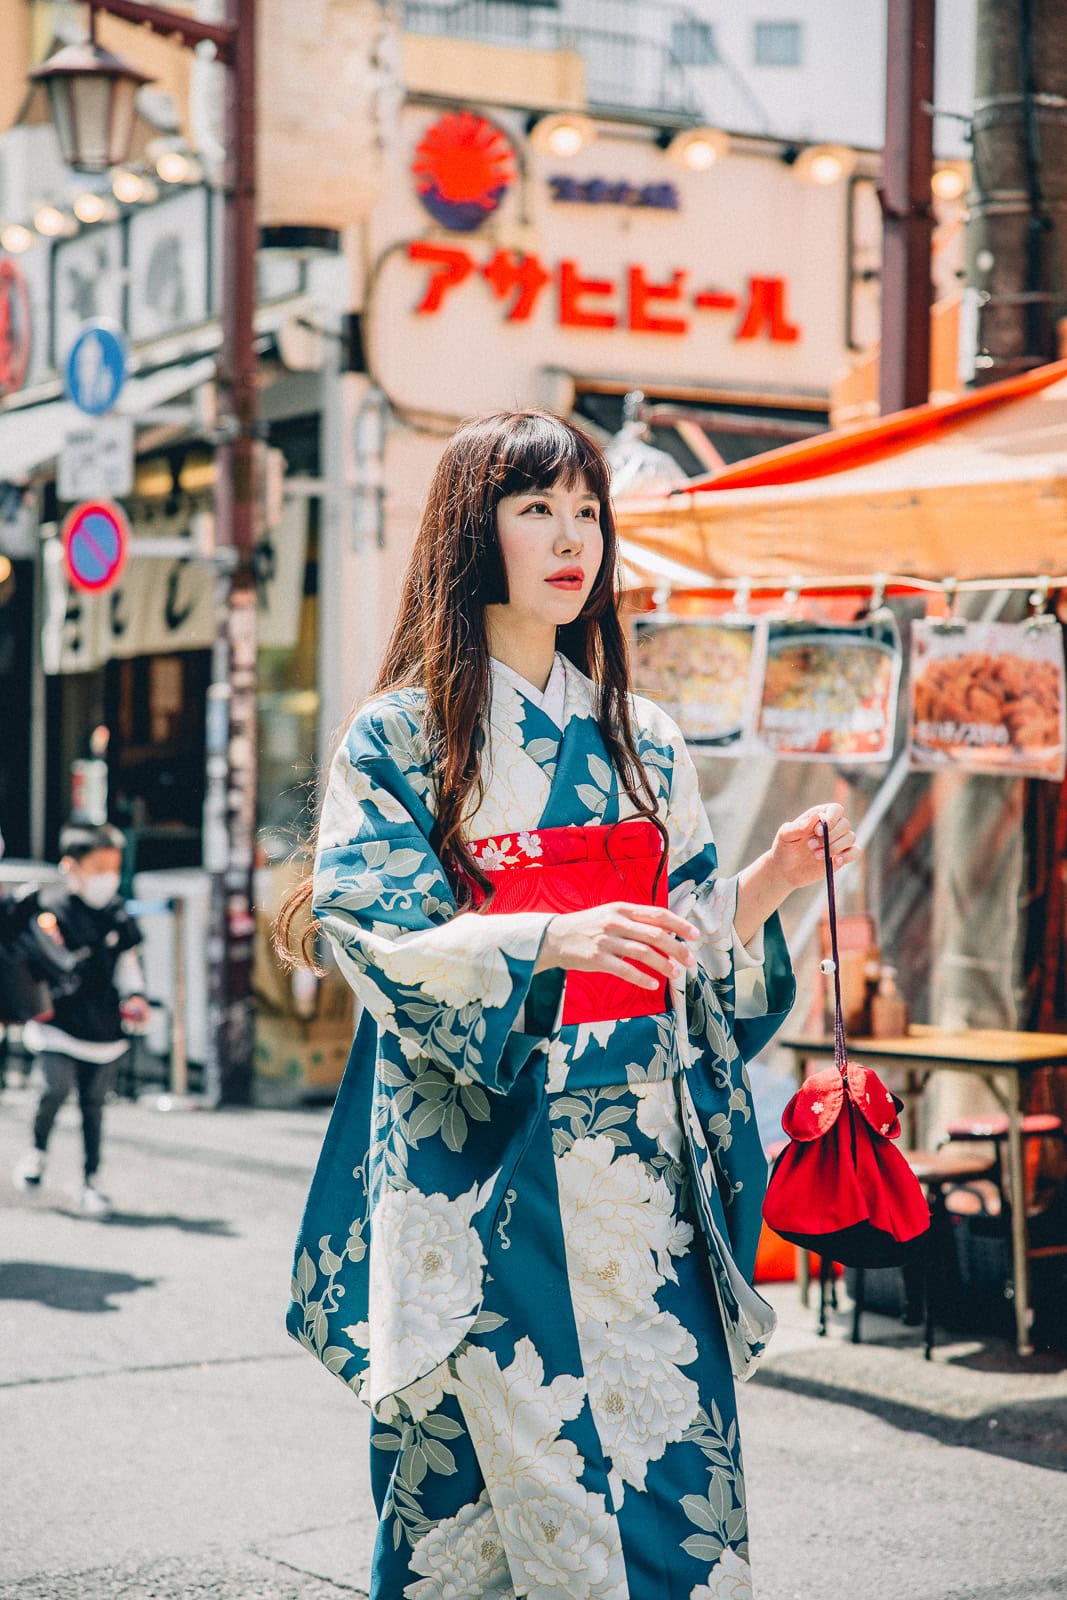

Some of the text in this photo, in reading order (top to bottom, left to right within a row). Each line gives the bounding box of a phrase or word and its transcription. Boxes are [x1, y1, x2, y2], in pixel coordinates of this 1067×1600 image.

[406, 240, 800, 343] アサヒビール
